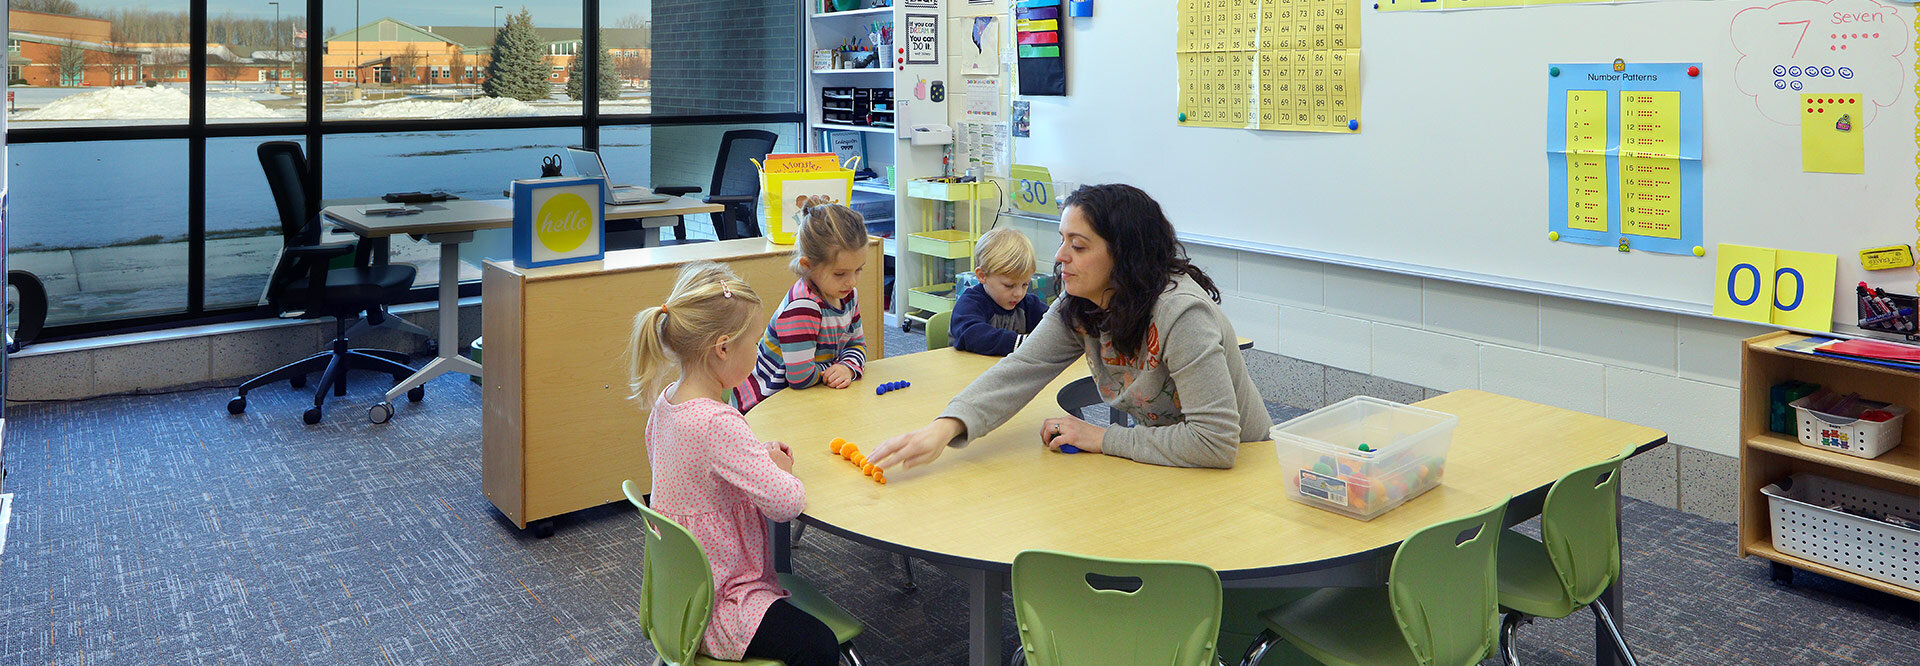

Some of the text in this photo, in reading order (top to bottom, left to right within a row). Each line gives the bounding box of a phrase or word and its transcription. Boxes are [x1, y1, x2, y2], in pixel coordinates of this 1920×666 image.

[913, 42, 923, 50] DO
[1778, 20, 1810, 58] 7
[1588, 73, 1658, 81] Number Patterns
[1020, 179, 1047, 205] 30
[541, 208, 586, 232] hello
[1727, 263, 1804, 311] 0 0
